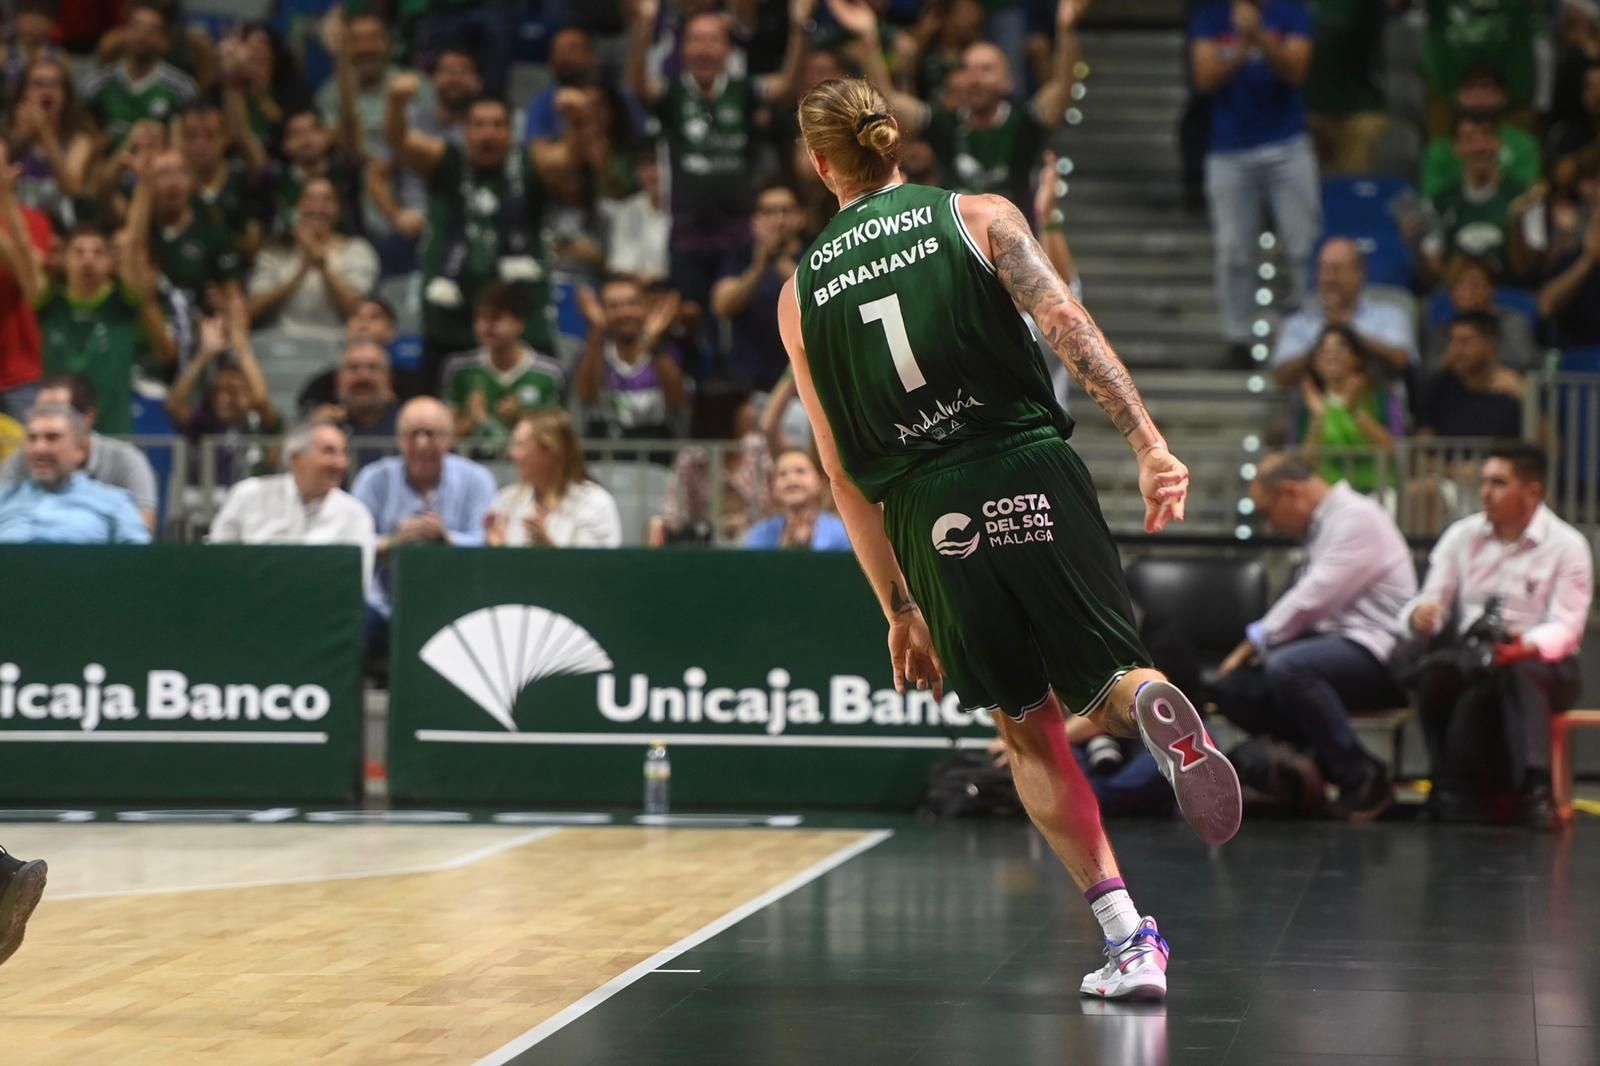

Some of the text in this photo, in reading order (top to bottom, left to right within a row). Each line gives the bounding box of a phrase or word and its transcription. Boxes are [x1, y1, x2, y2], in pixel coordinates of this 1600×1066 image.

[810, 206, 933, 271] OSETKOWSKI
[858, 293, 927, 393] 1
[894, 388, 985, 445] Andalucía
[982, 494, 1051, 517] COSTA
[985, 513, 1054, 534] DEL SOL
[990, 529, 1054, 547] MÁLAGA
[147, 670, 330, 720] Banco
[597, 667, 823, 735] Unicaja
